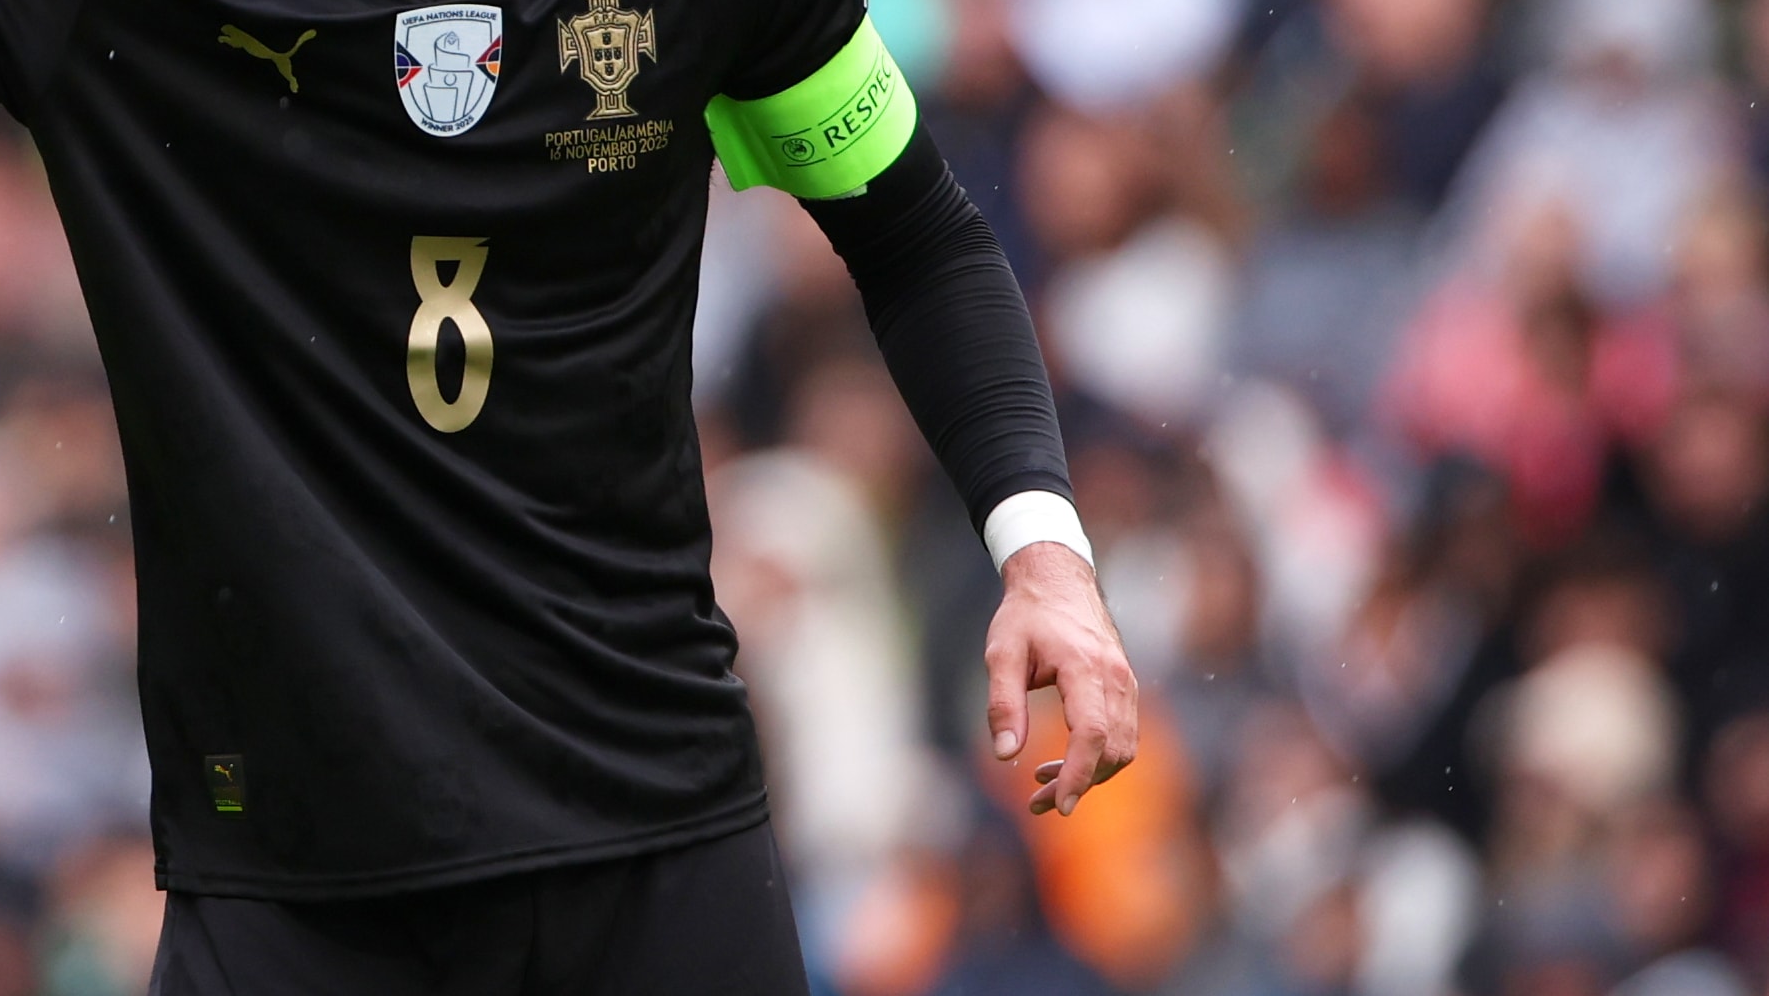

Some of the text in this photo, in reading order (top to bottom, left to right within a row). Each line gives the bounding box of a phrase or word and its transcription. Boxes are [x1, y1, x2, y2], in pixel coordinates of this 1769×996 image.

[402, 10, 498, 25] UEFA NATIONS LEAGUE
[823, 52, 892, 149] RESPEC
[421, 115, 475, 132] WINNER 2025
[550, 134, 669, 161] 16 NOVEMBRO 2025
[588, 155, 636, 173] PORTO
[406, 235, 494, 433] 8
